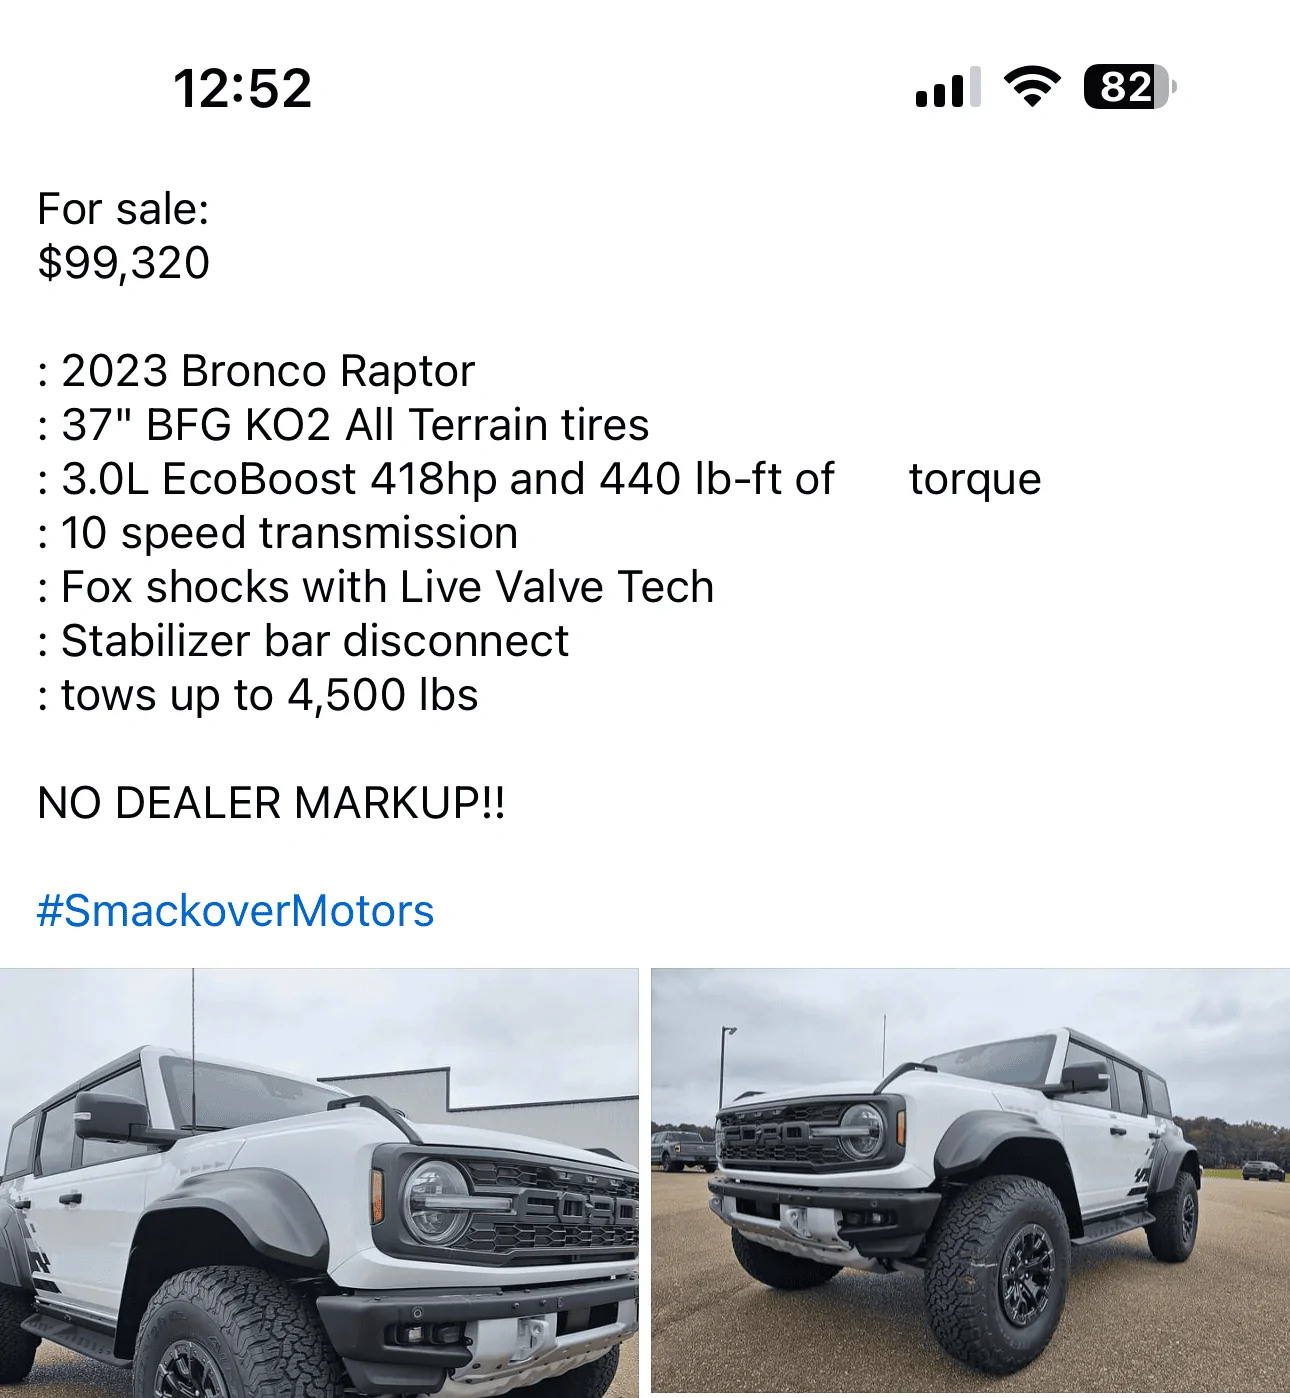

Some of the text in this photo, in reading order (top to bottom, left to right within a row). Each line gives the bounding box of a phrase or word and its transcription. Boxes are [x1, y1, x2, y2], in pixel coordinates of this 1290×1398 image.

[175, 68, 311, 108] 12:52
[1101, 71, 1152, 103] 82
[40, 191, 207, 225] For sale:
[39, 243, 209, 286] $99,320
[40, 353, 475, 394] : 2023 Bronco Raptor
[39, 406, 648, 441] : 37" BFG KO2 All Terrain tires
[40, 460, 1041, 502] : 3.0L EcoBoost 418hp and 440 lb-ft of torque
[39, 514, 516, 556] : 10 speed transmission
[40, 568, 712, 603] : Fox shocks with Live Valve Tech
[39, 622, 569, 657] : Stabilizer bar disconnect
[40, 677, 477, 718] : tows up to 4,500 lbs
[40, 785, 503, 819] NO DEALER MARKUP!!
[37, 893, 433, 927] #SmackoverMotors
